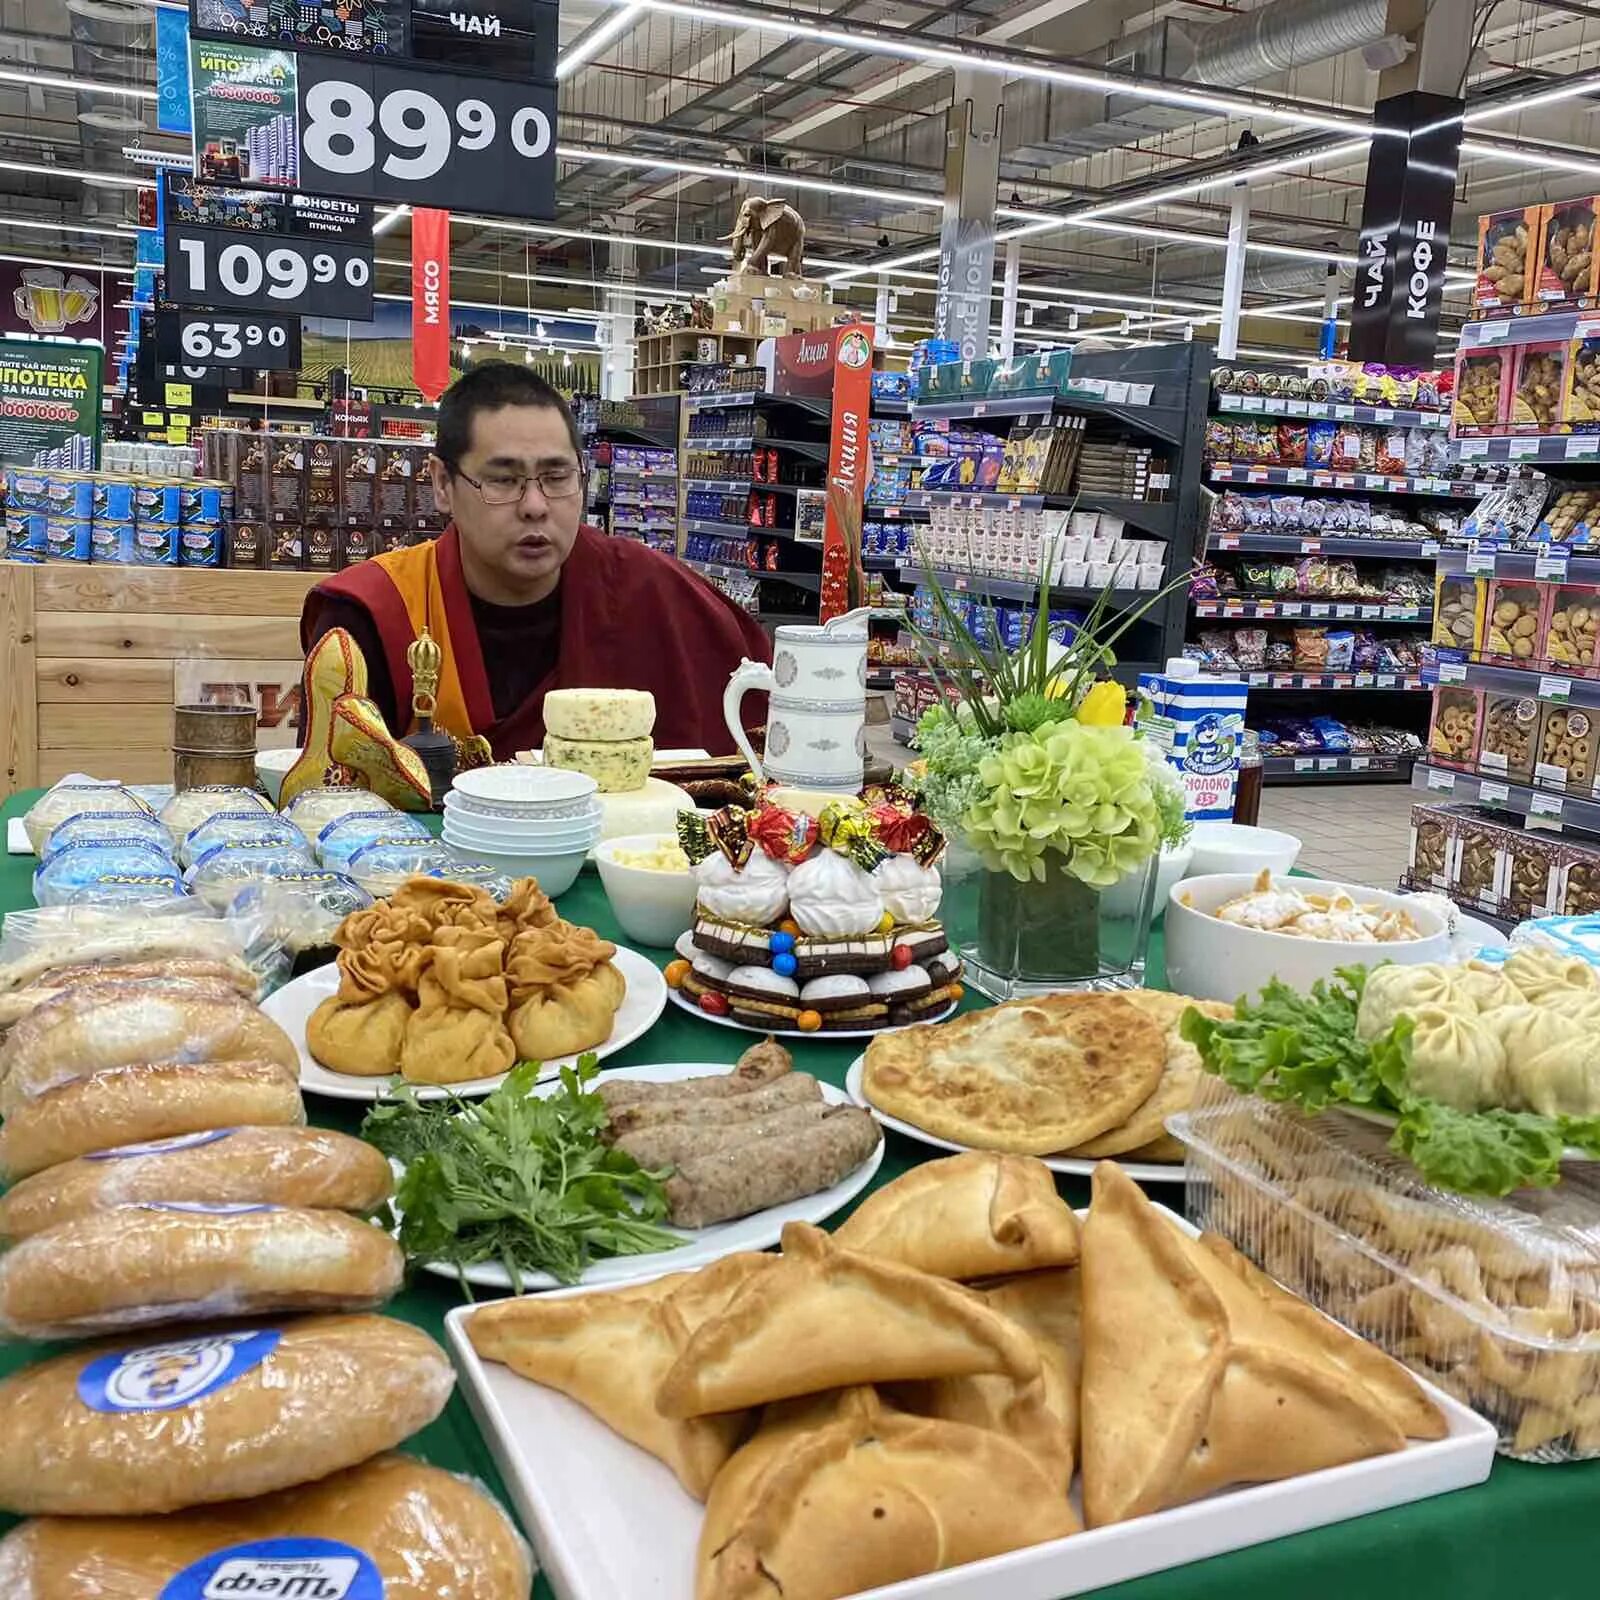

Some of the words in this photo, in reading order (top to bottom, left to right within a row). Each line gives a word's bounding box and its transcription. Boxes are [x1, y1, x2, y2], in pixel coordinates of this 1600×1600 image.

[450, 12, 501, 37] ЧАЙ
[303, 80, 452, 181] 89
[309, 222, 343, 233] ПТИЧКА
[179, 238, 308, 300] 109
[1363, 234, 1389, 308] ЧАЙ
[1407, 220, 1436, 319] КОФЕ
[424, 260, 440, 325] МЯСО
[181, 322, 242, 359] 63
[796, 338, 829, 366] Акция
[0, 368, 88, 390] ПОТЕКА
[21, 361, 39, 370] ЧАЙ
[2, 384, 19, 394] ЗА
[21, 386, 49, 396] НАШ
[832, 411, 860, 495] Акция
[1185, 777, 1230, 791] МОЛОКО
